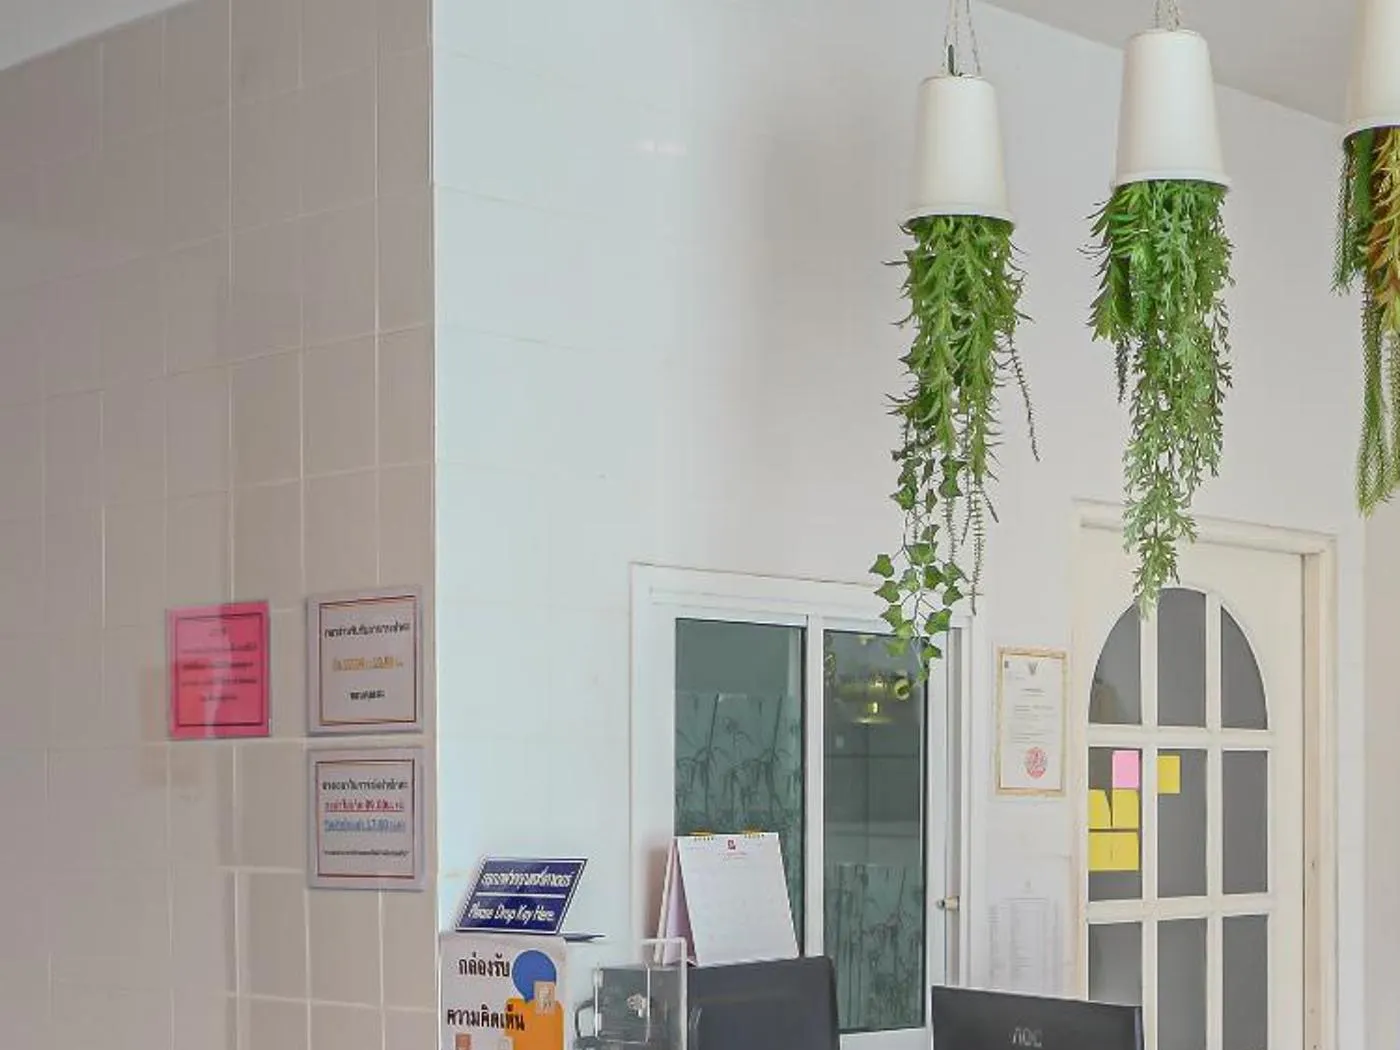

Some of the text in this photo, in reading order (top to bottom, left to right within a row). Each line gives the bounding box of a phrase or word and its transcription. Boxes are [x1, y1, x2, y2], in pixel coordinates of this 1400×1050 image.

[494, 903, 516, 925] Drop
[516, 904, 536, 926] Key
[458, 952, 511, 978] กล่องรับ
[446, 1003, 526, 1032] ความคิดเห็น
